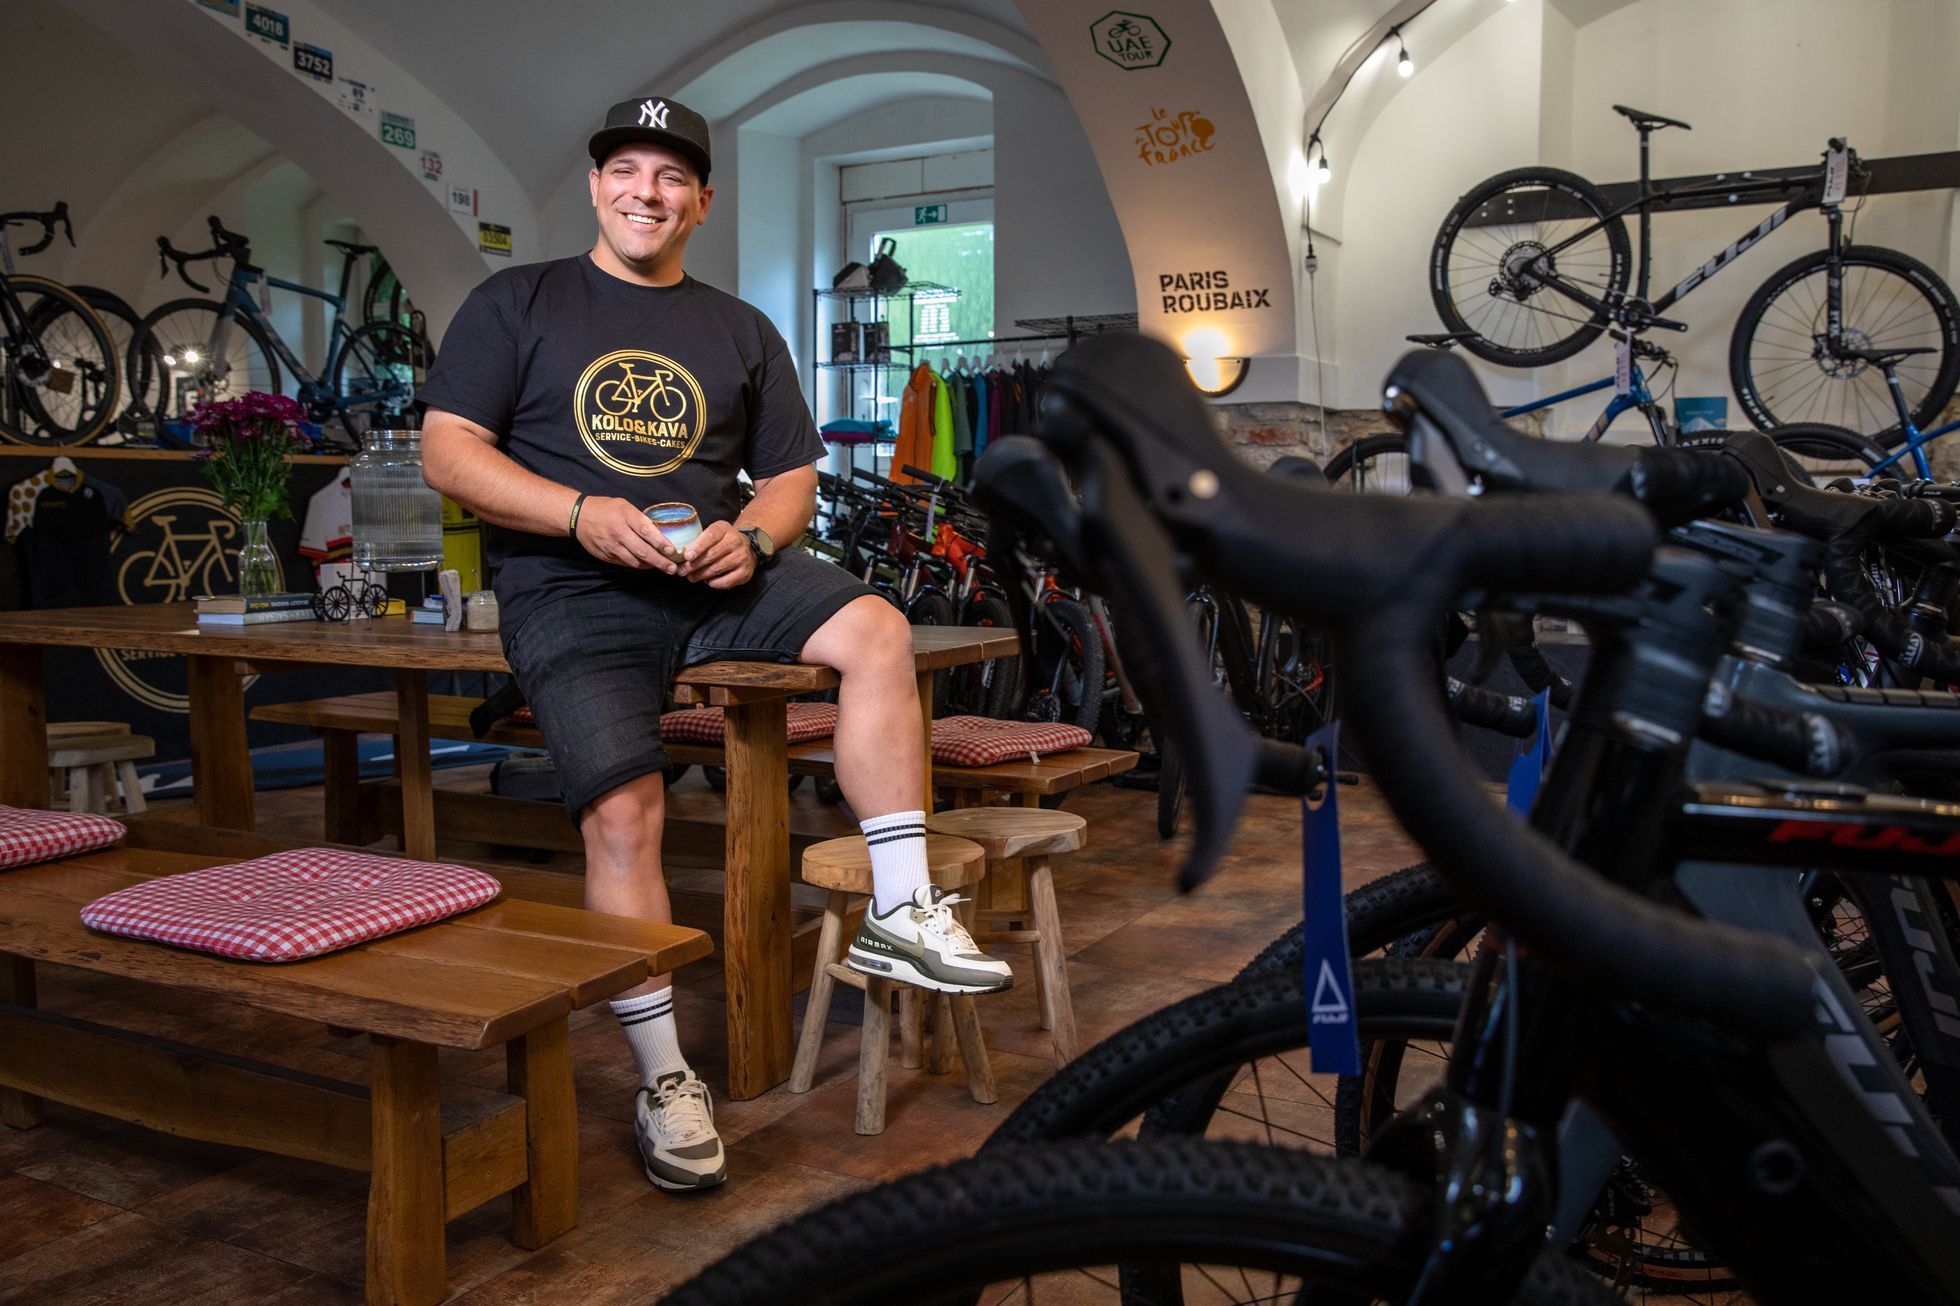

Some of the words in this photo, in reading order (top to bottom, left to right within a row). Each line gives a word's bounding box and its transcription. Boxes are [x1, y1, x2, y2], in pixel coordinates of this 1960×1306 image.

[252, 13, 284, 36] 4018
[1107, 35, 1154, 54] UAE
[297, 51, 331, 75] 3752
[1117, 50, 1154, 62] TOUR
[638, 99, 670, 129] NY
[383, 125, 414, 147] 269
[421, 157, 443, 174] 132
[1159, 271, 1229, 292] PARIS
[1163, 289, 1271, 313] ROUBAIX
[592, 414, 688, 439] KOLO&KAVA
